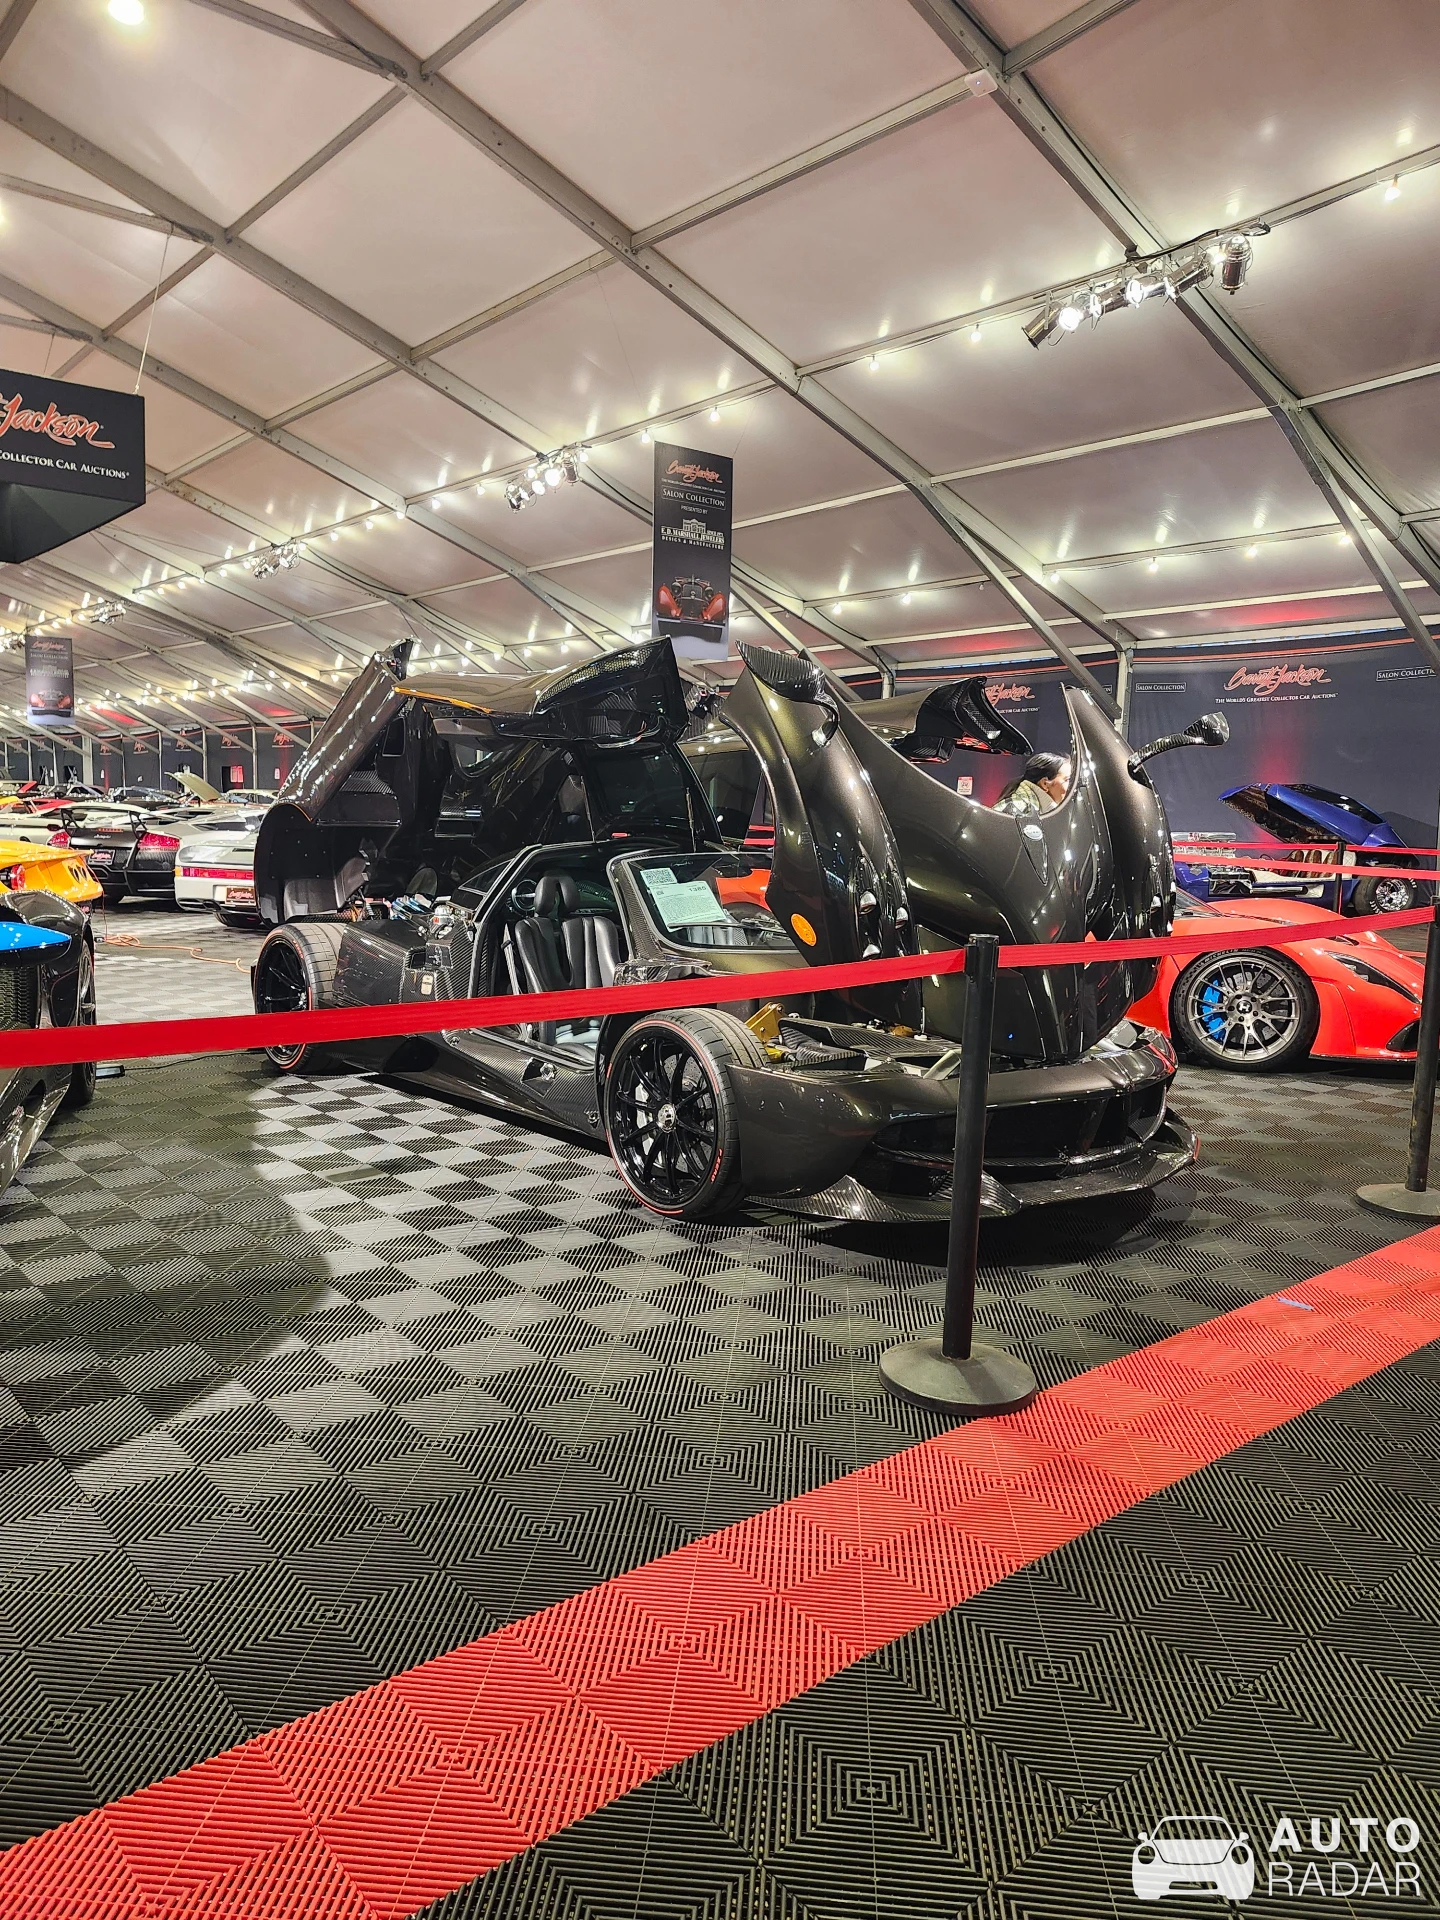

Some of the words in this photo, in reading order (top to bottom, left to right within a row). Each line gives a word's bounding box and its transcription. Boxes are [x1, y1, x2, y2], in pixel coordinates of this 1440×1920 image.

[56, 460, 77, 471] CAR
[663, 488, 684, 499] SALON
[685, 493, 725, 507] COLLECTION
[681, 505, 702, 513] PRESENTED
